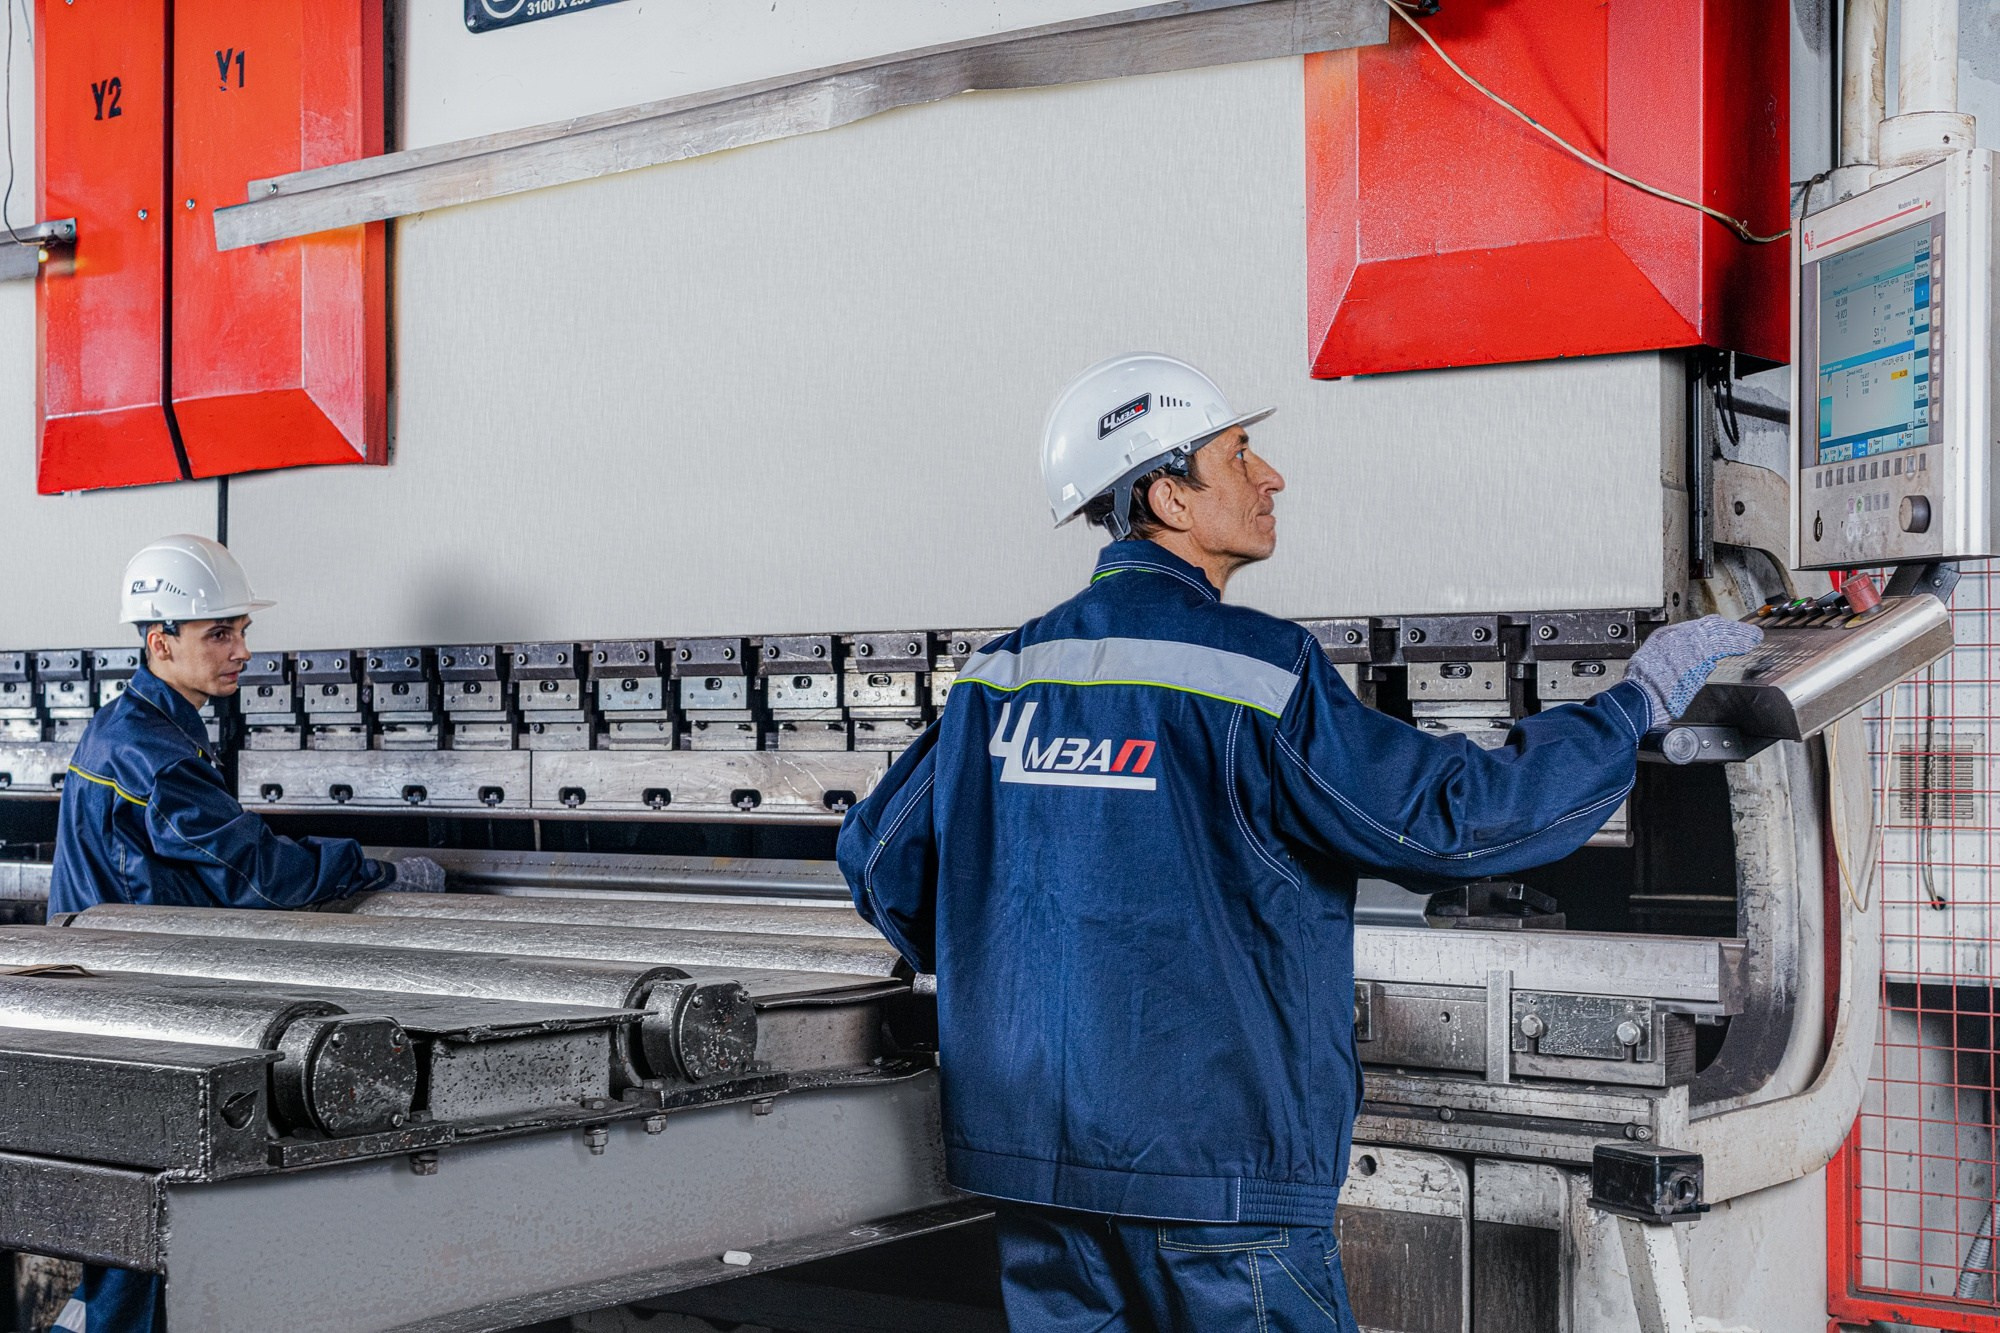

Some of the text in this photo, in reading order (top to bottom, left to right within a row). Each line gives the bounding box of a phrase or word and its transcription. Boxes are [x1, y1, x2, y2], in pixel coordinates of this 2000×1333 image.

[527, 0, 555, 16] 3100
[215, 48, 245, 91] Y1
[91, 77, 122, 121] Y2
